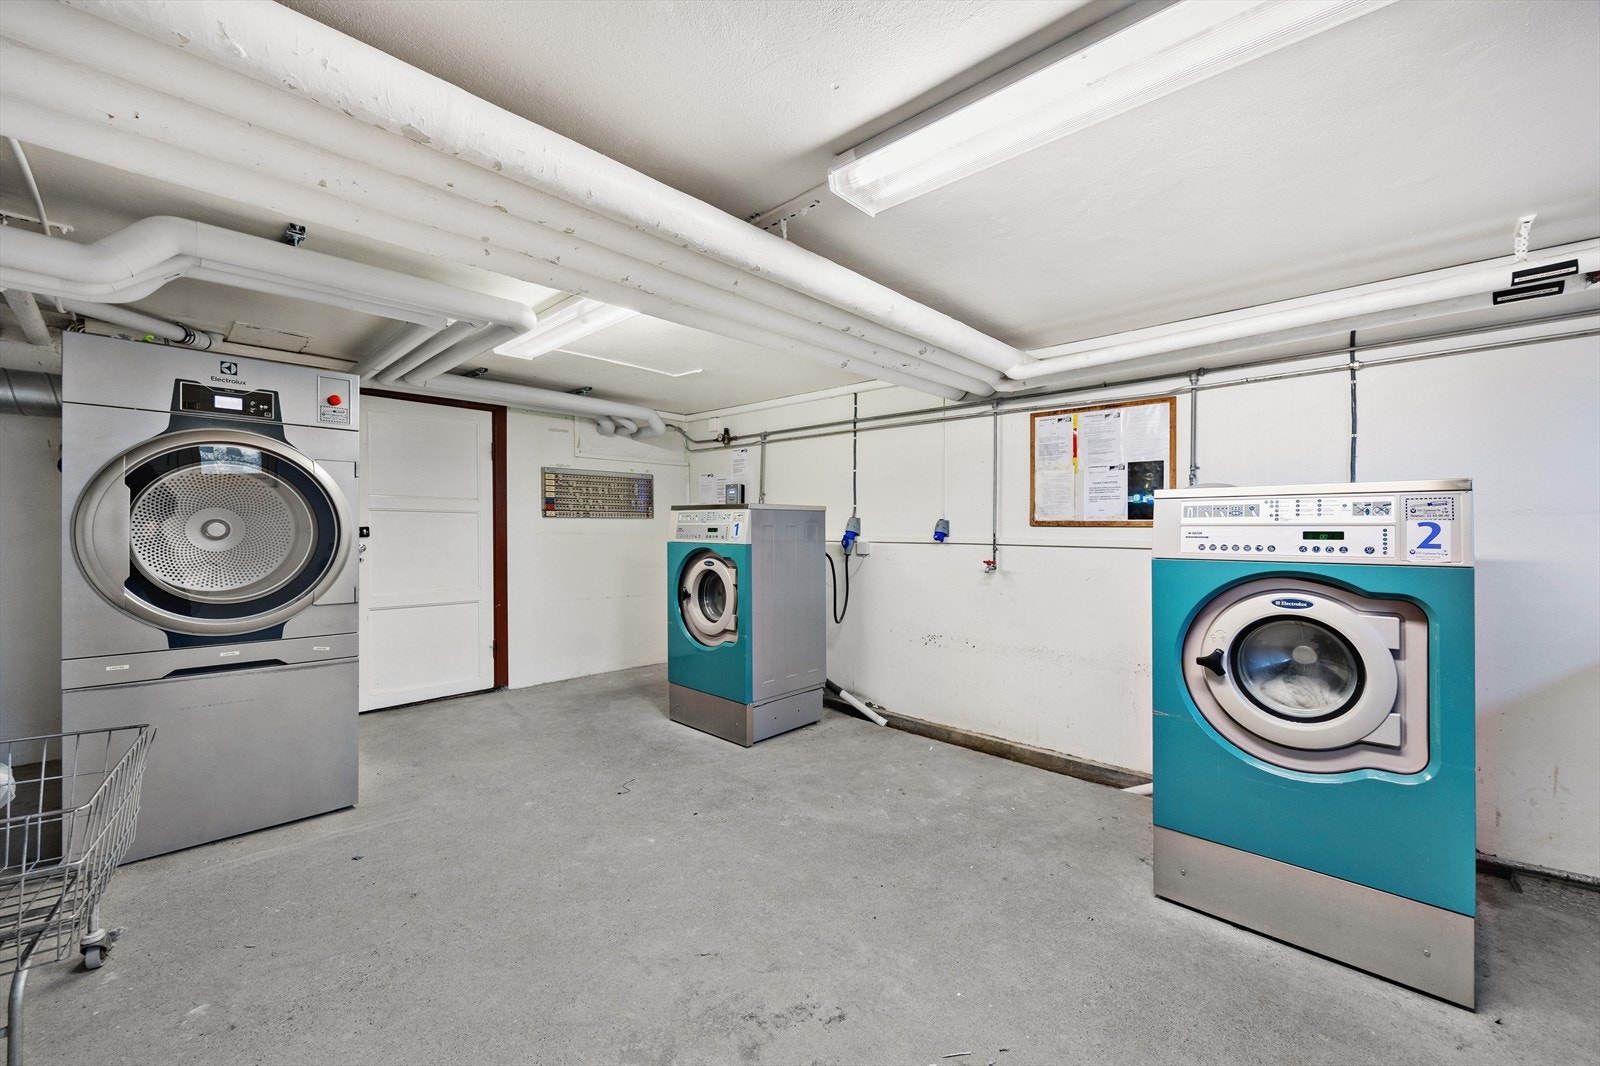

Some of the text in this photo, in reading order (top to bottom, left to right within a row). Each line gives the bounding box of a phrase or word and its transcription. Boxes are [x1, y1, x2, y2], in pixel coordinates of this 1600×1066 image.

[210, 376, 246, 386] Electrolux
[734, 523, 740, 536] 1
[1416, 522, 1442, 549] 2
